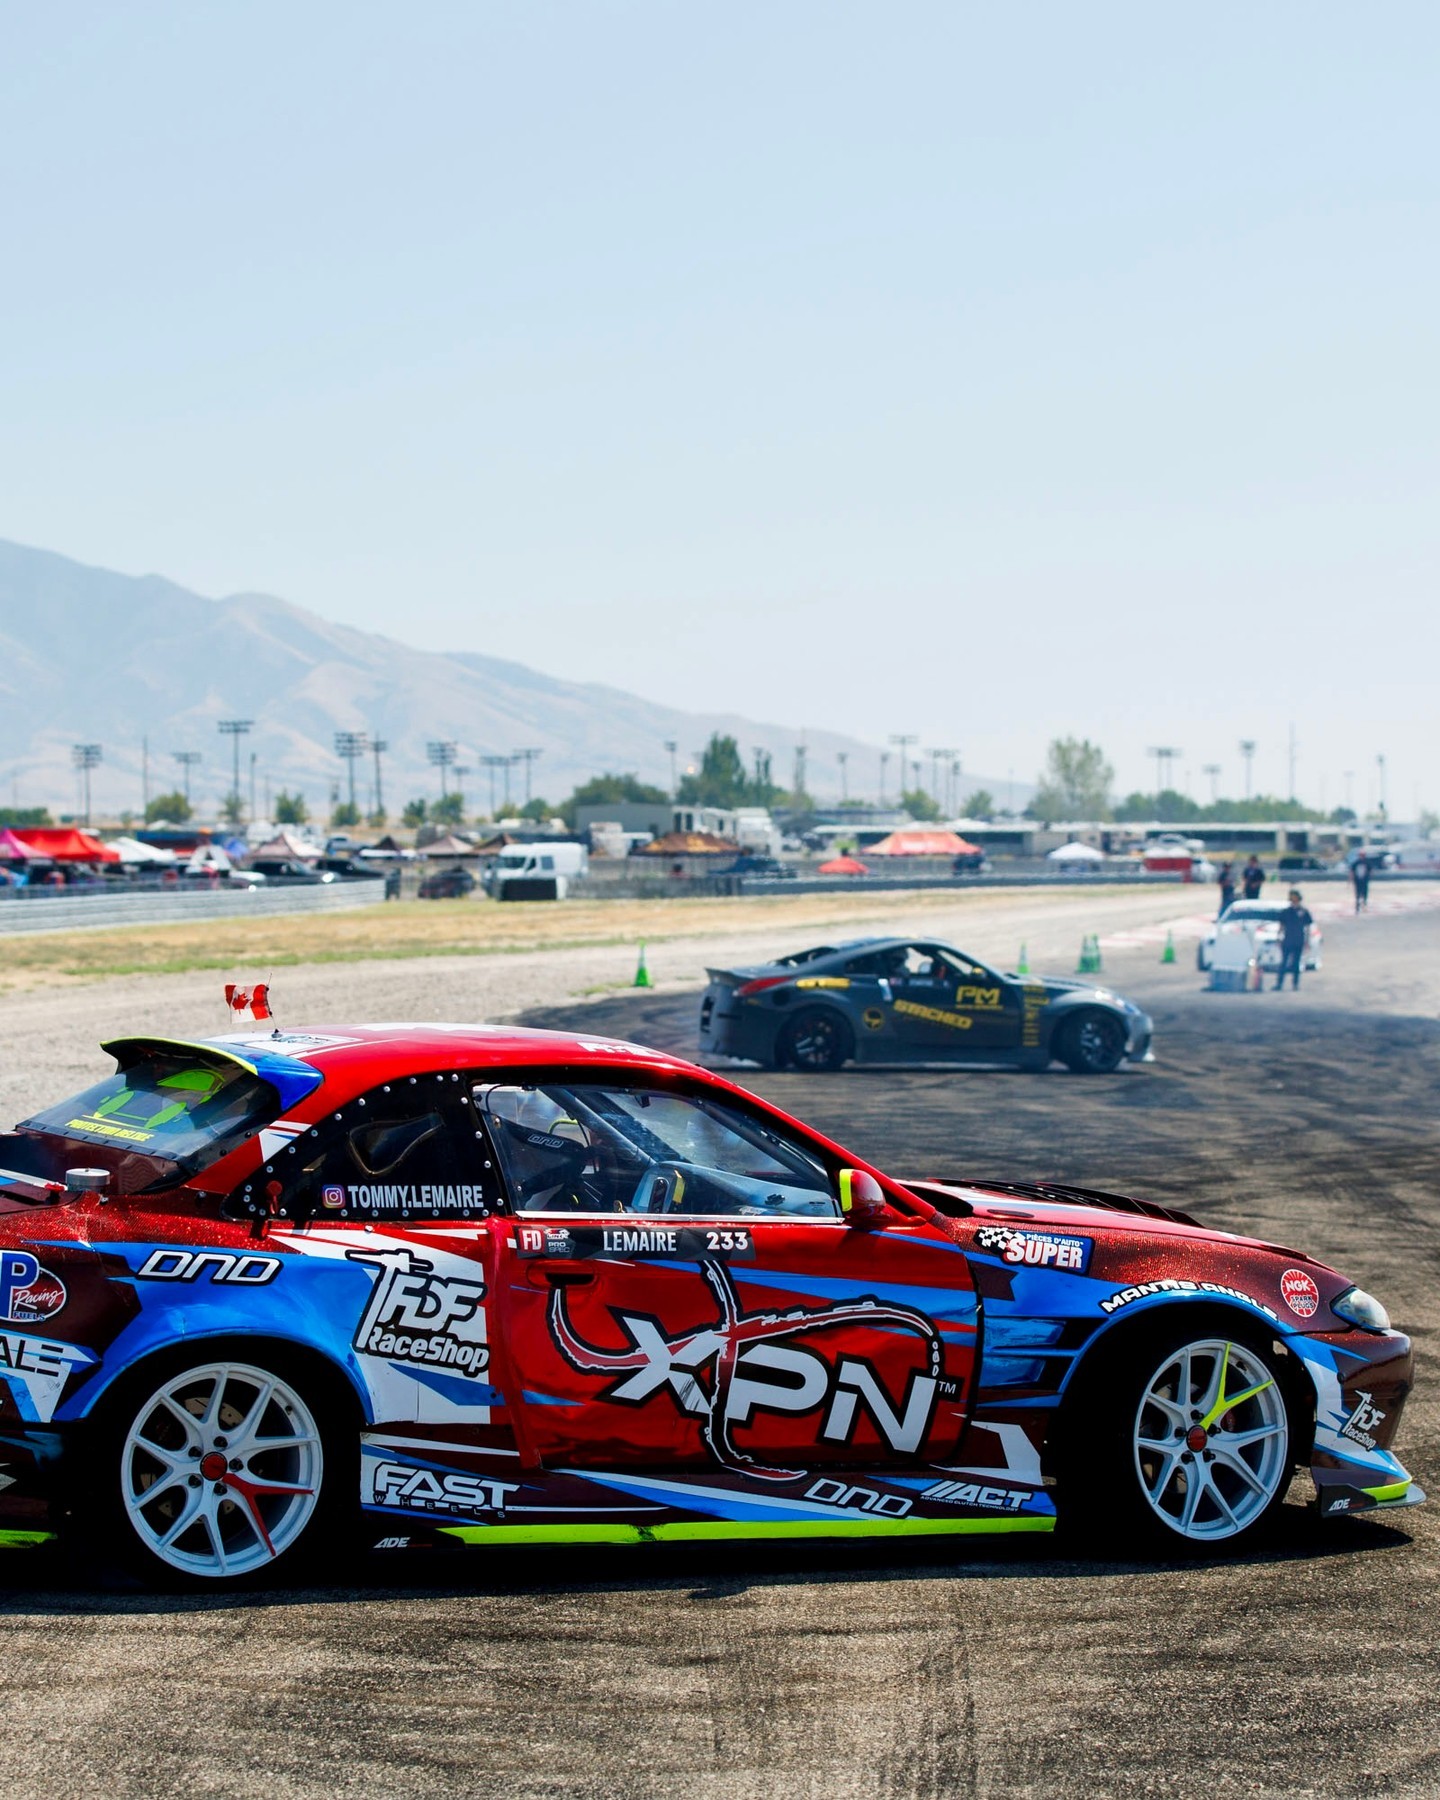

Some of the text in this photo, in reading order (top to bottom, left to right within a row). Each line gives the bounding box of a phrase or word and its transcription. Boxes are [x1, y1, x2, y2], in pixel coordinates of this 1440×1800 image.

[956, 985, 1000, 1004] PM
[347, 1185, 484, 1208] TOMMY.LEMAIRE
[522, 1229, 542, 1250] FD
[603, 1231, 748, 1251] LEMAIRE 233
[1006, 1238, 1083, 1268] SUPER
[137, 1249, 281, 1283] DND
[1285, 1280, 1311, 1292] NGK
[14, 1288, 64, 1311] Racing
[1101, 1279, 1278, 1321] MANTIS ANGLE
[1292, 1301, 1315, 1309] PLUGS
[13, 1310, 46, 1321] FUELS
[367, 1326, 490, 1372] RaceShop
[374, 1463, 521, 1509] FAST
[804, 1477, 914, 1517] DND
[920, 1496, 1019, 1512] ADVANCED CLUTCH TECHNOLOGY
[373, 1536, 411, 1549] ADE
